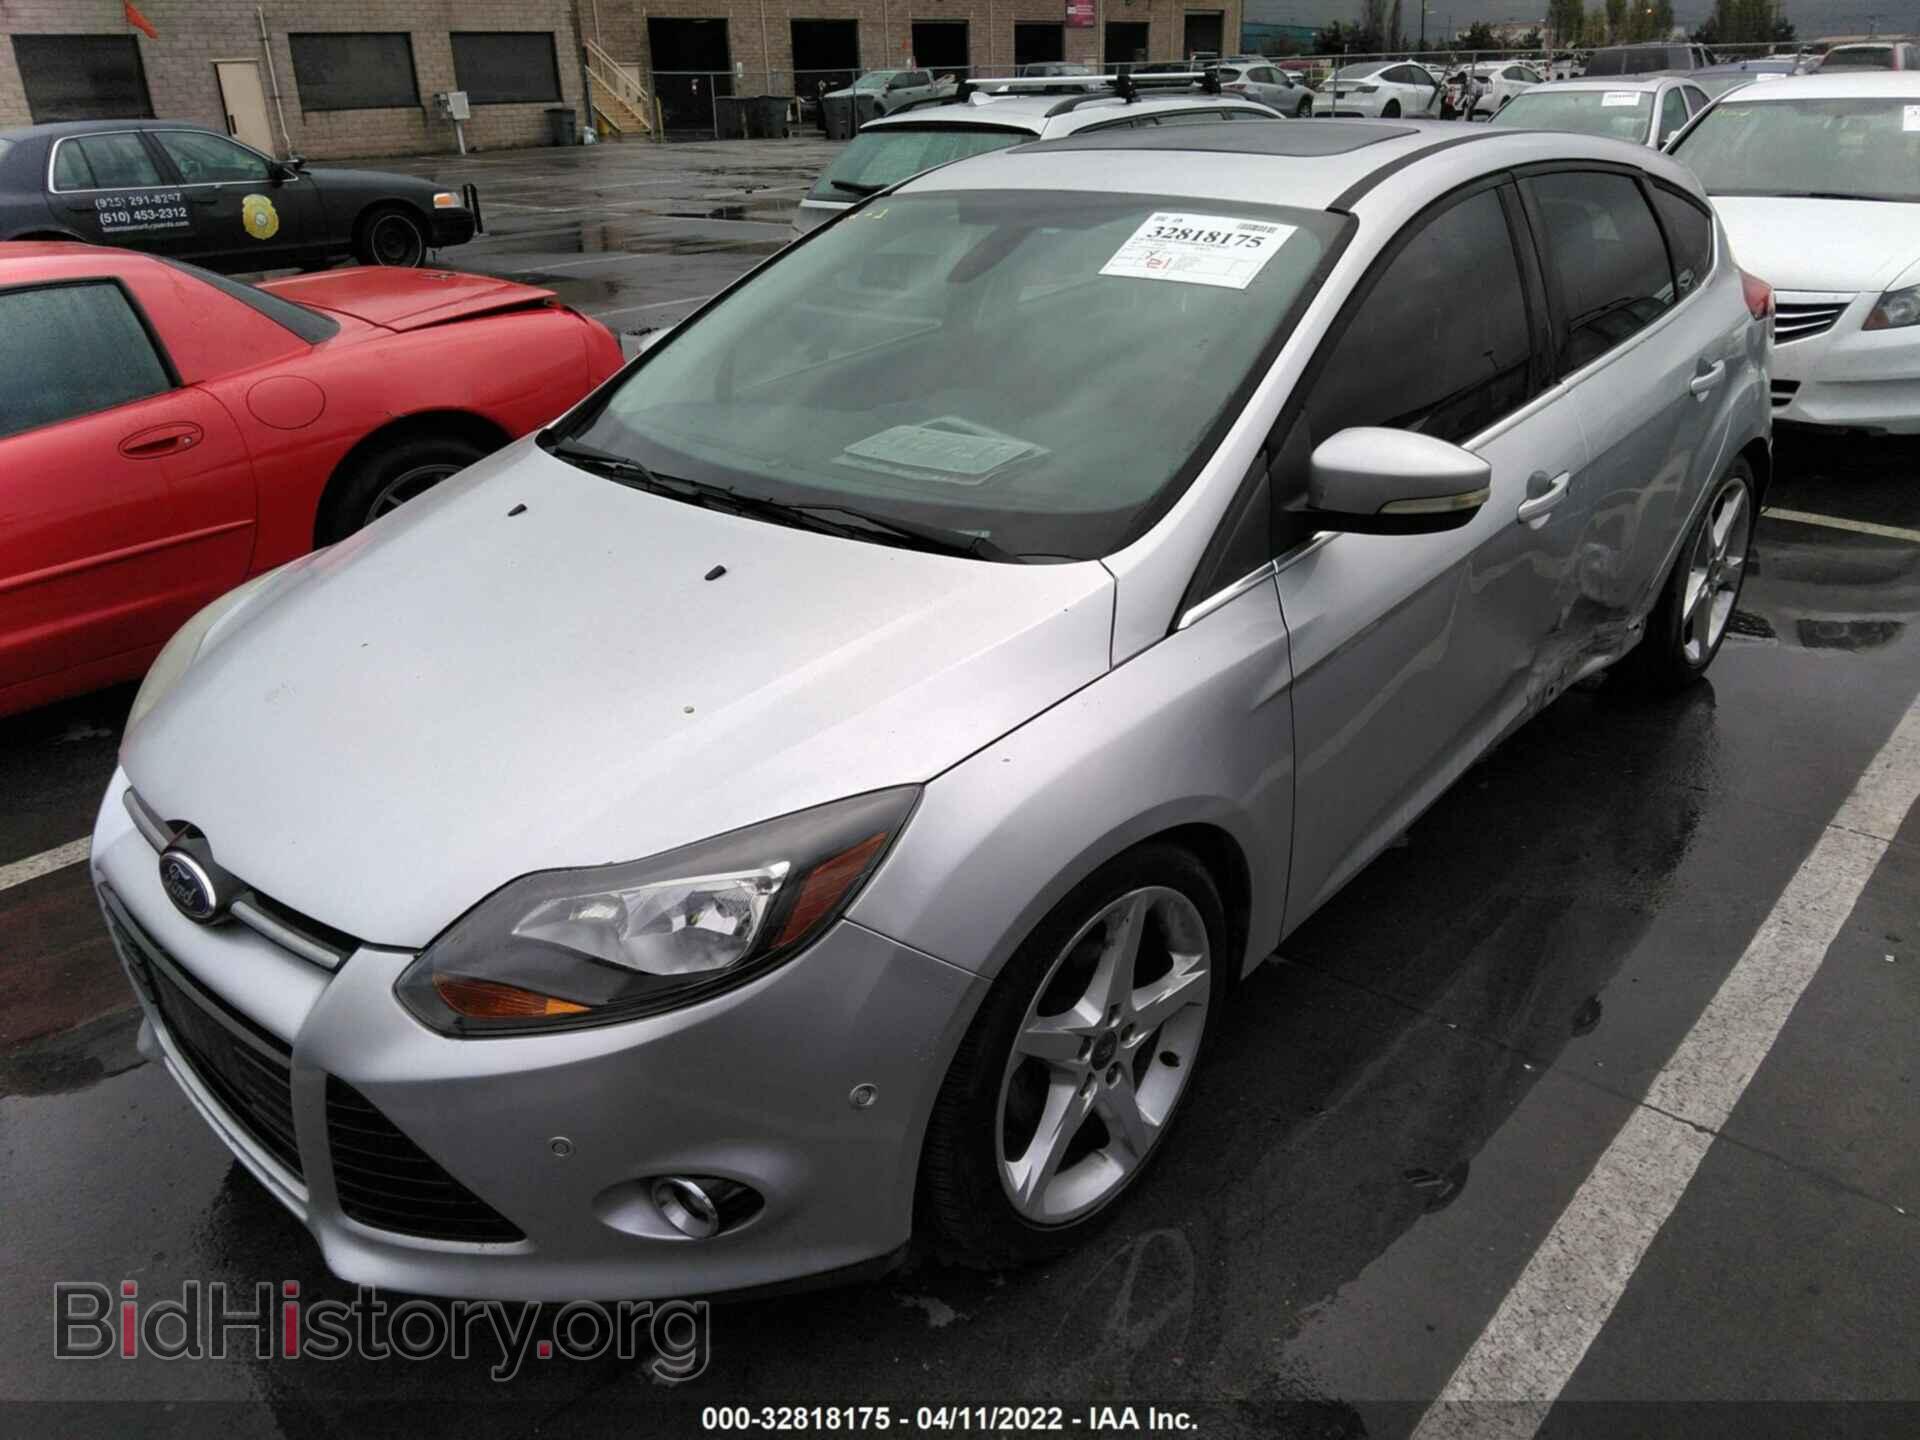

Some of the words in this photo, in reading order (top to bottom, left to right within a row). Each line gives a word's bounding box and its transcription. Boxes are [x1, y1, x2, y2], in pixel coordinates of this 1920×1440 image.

[99, 211, 130, 226] (510)
[133, 207, 188, 220] 453-2312
[1146, 226, 1266, 249] 32818175
[165, 862, 198, 907] Ford
